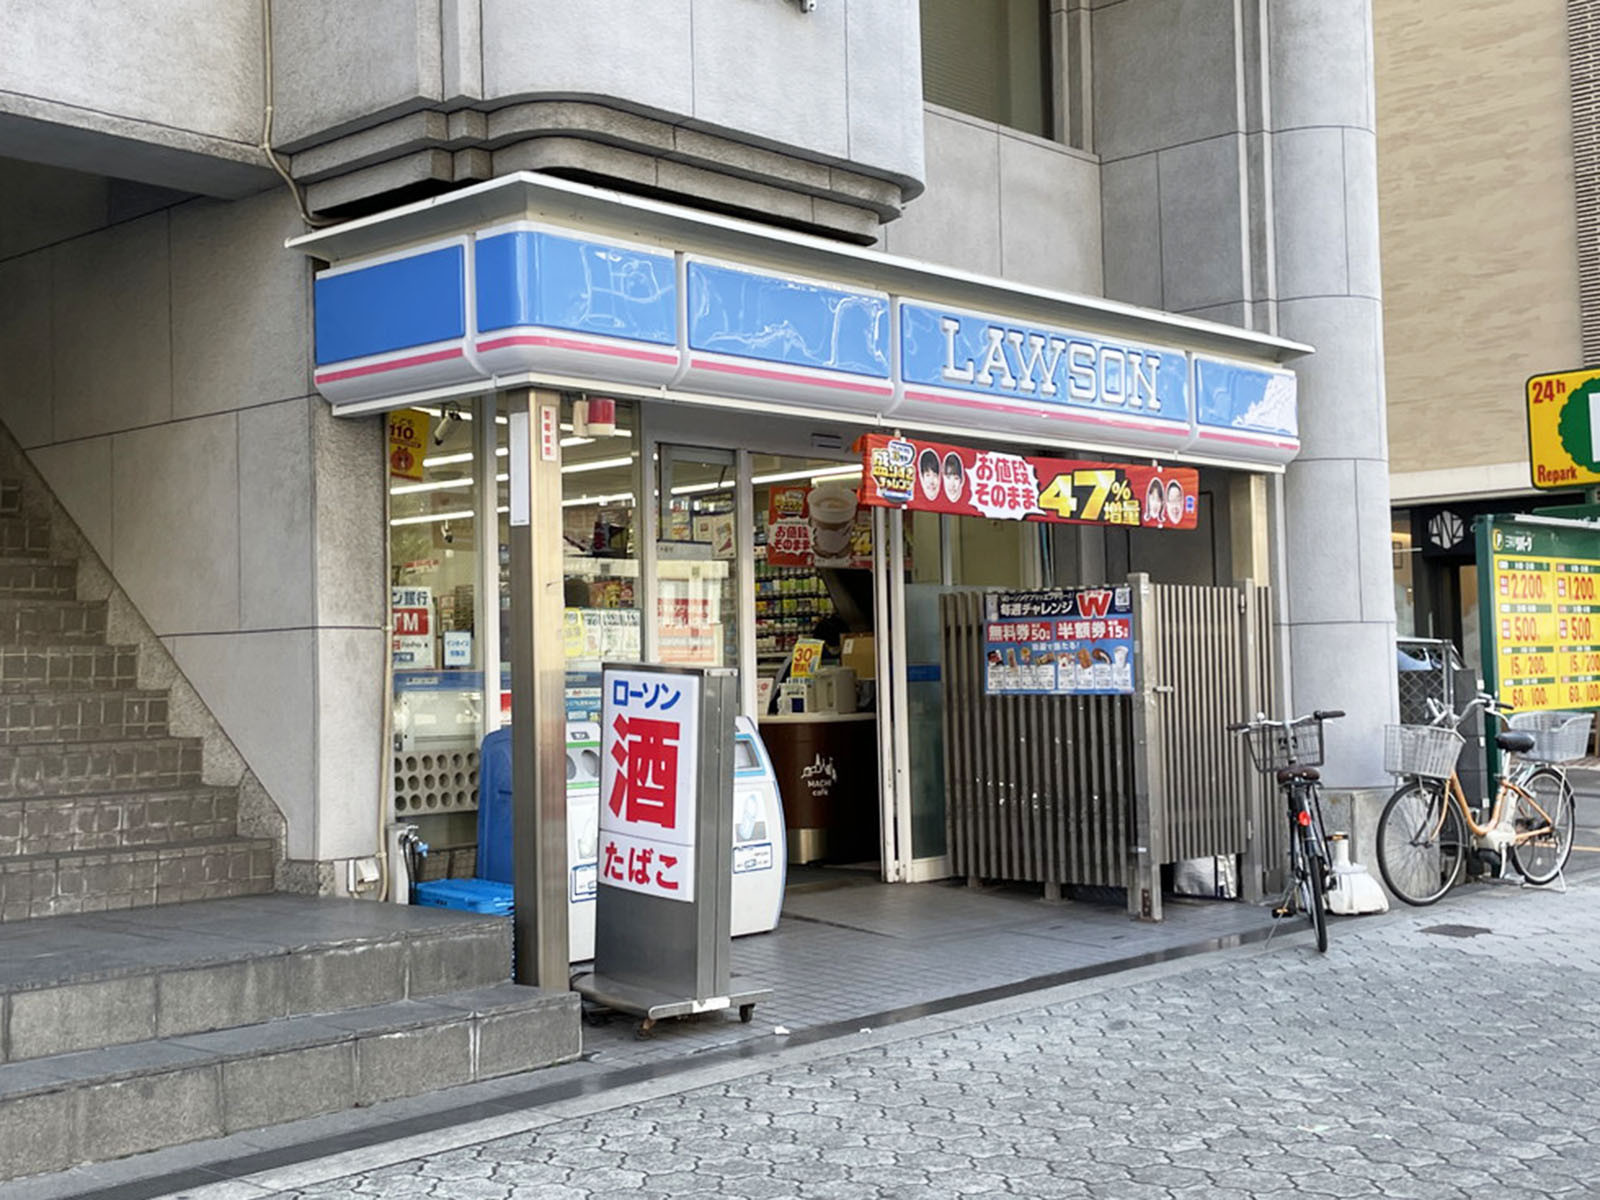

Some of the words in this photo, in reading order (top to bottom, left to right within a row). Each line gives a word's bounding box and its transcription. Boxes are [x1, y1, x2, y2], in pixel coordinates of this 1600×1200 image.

[941, 316, 1161, 412] LAWSON
[390, 424, 414, 440] 110
[976, 456, 1031, 486] お値段
[1537, 464, 1577, 484] Repark
[975, 483, 1035, 510] そのまま
[988, 623, 1030, 642] 無料券
[1057, 620, 1106, 642] 半額券
[794, 647, 812, 663] 30
[613, 679, 681, 711] ローソン
[608, 712, 681, 830] 酒
[603, 841, 679, 891] たばこ
